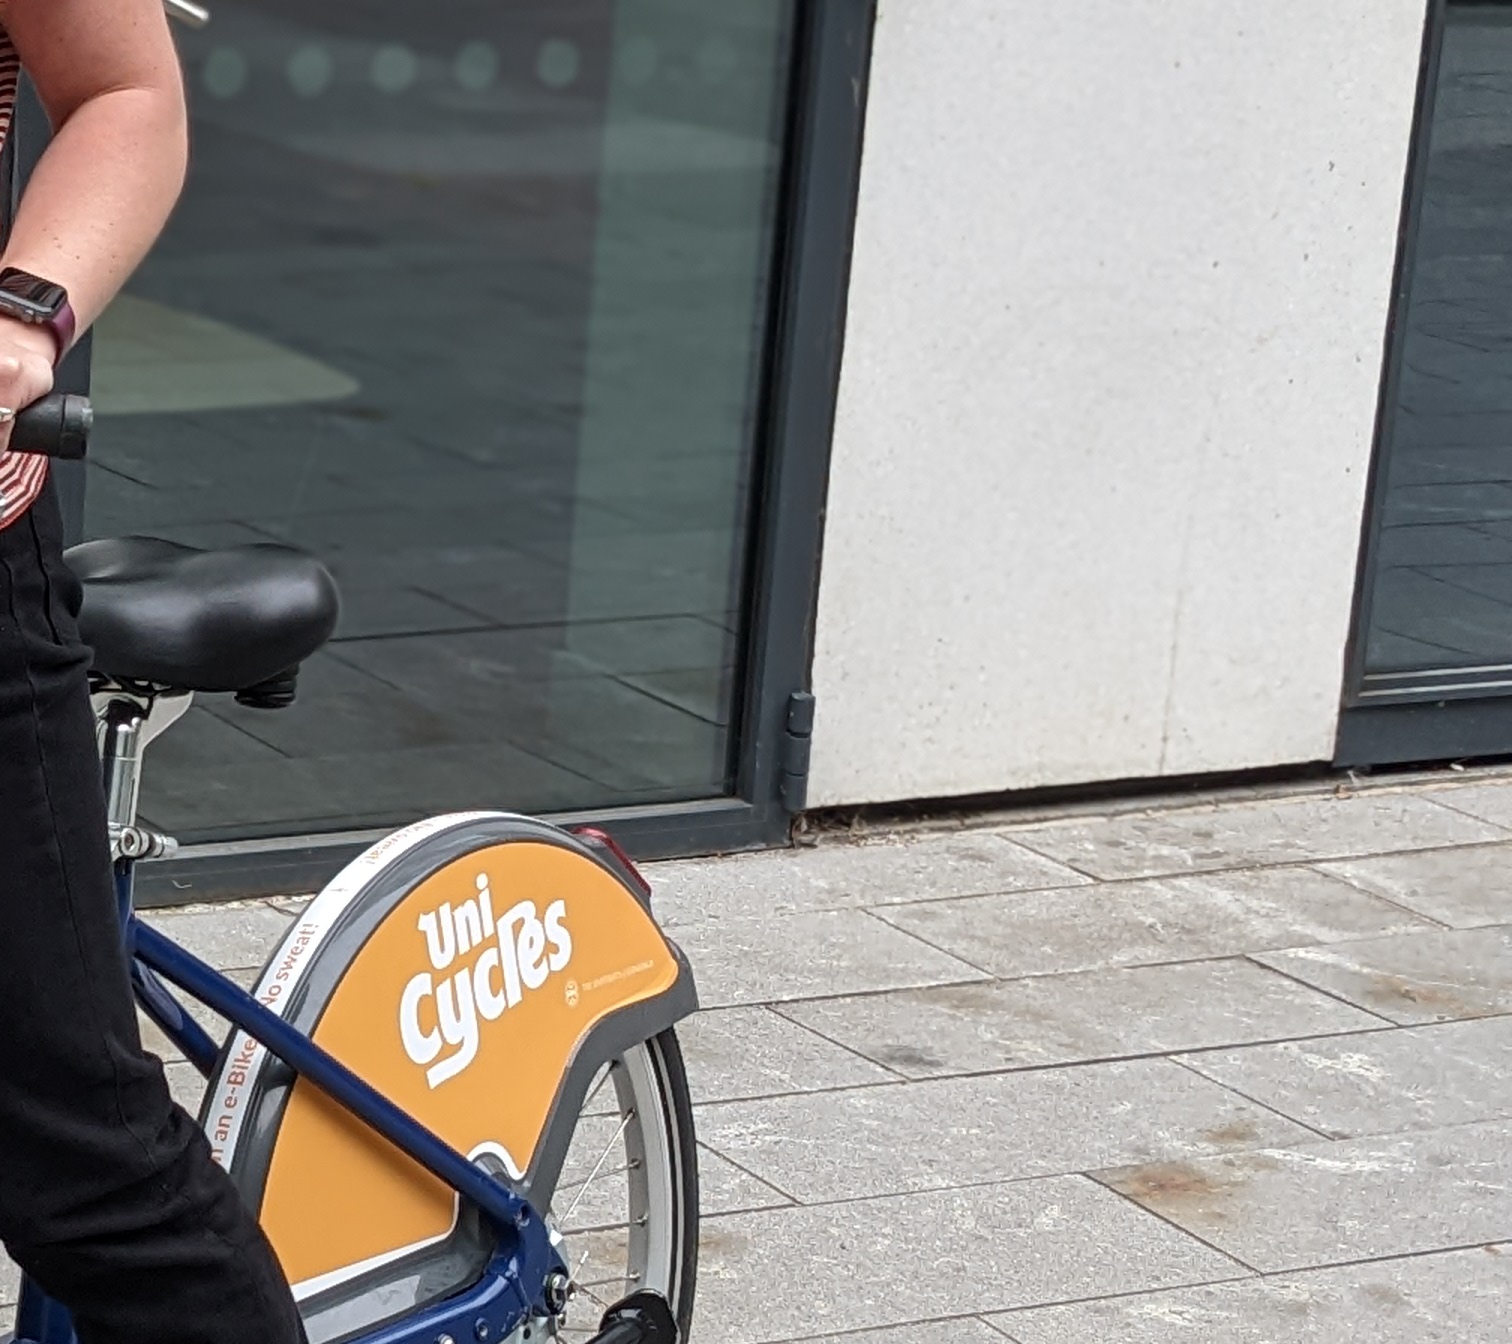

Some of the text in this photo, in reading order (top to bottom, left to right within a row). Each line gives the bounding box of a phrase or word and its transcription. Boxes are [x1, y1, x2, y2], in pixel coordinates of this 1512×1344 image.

[399, 899, 573, 1090] Cycles
[417, 872, 495, 970] Uni
[214, 1114, 233, 1142] an
[224, 1038, 258, 1109] e-Bike
[275, 923, 320, 982] sweat!
